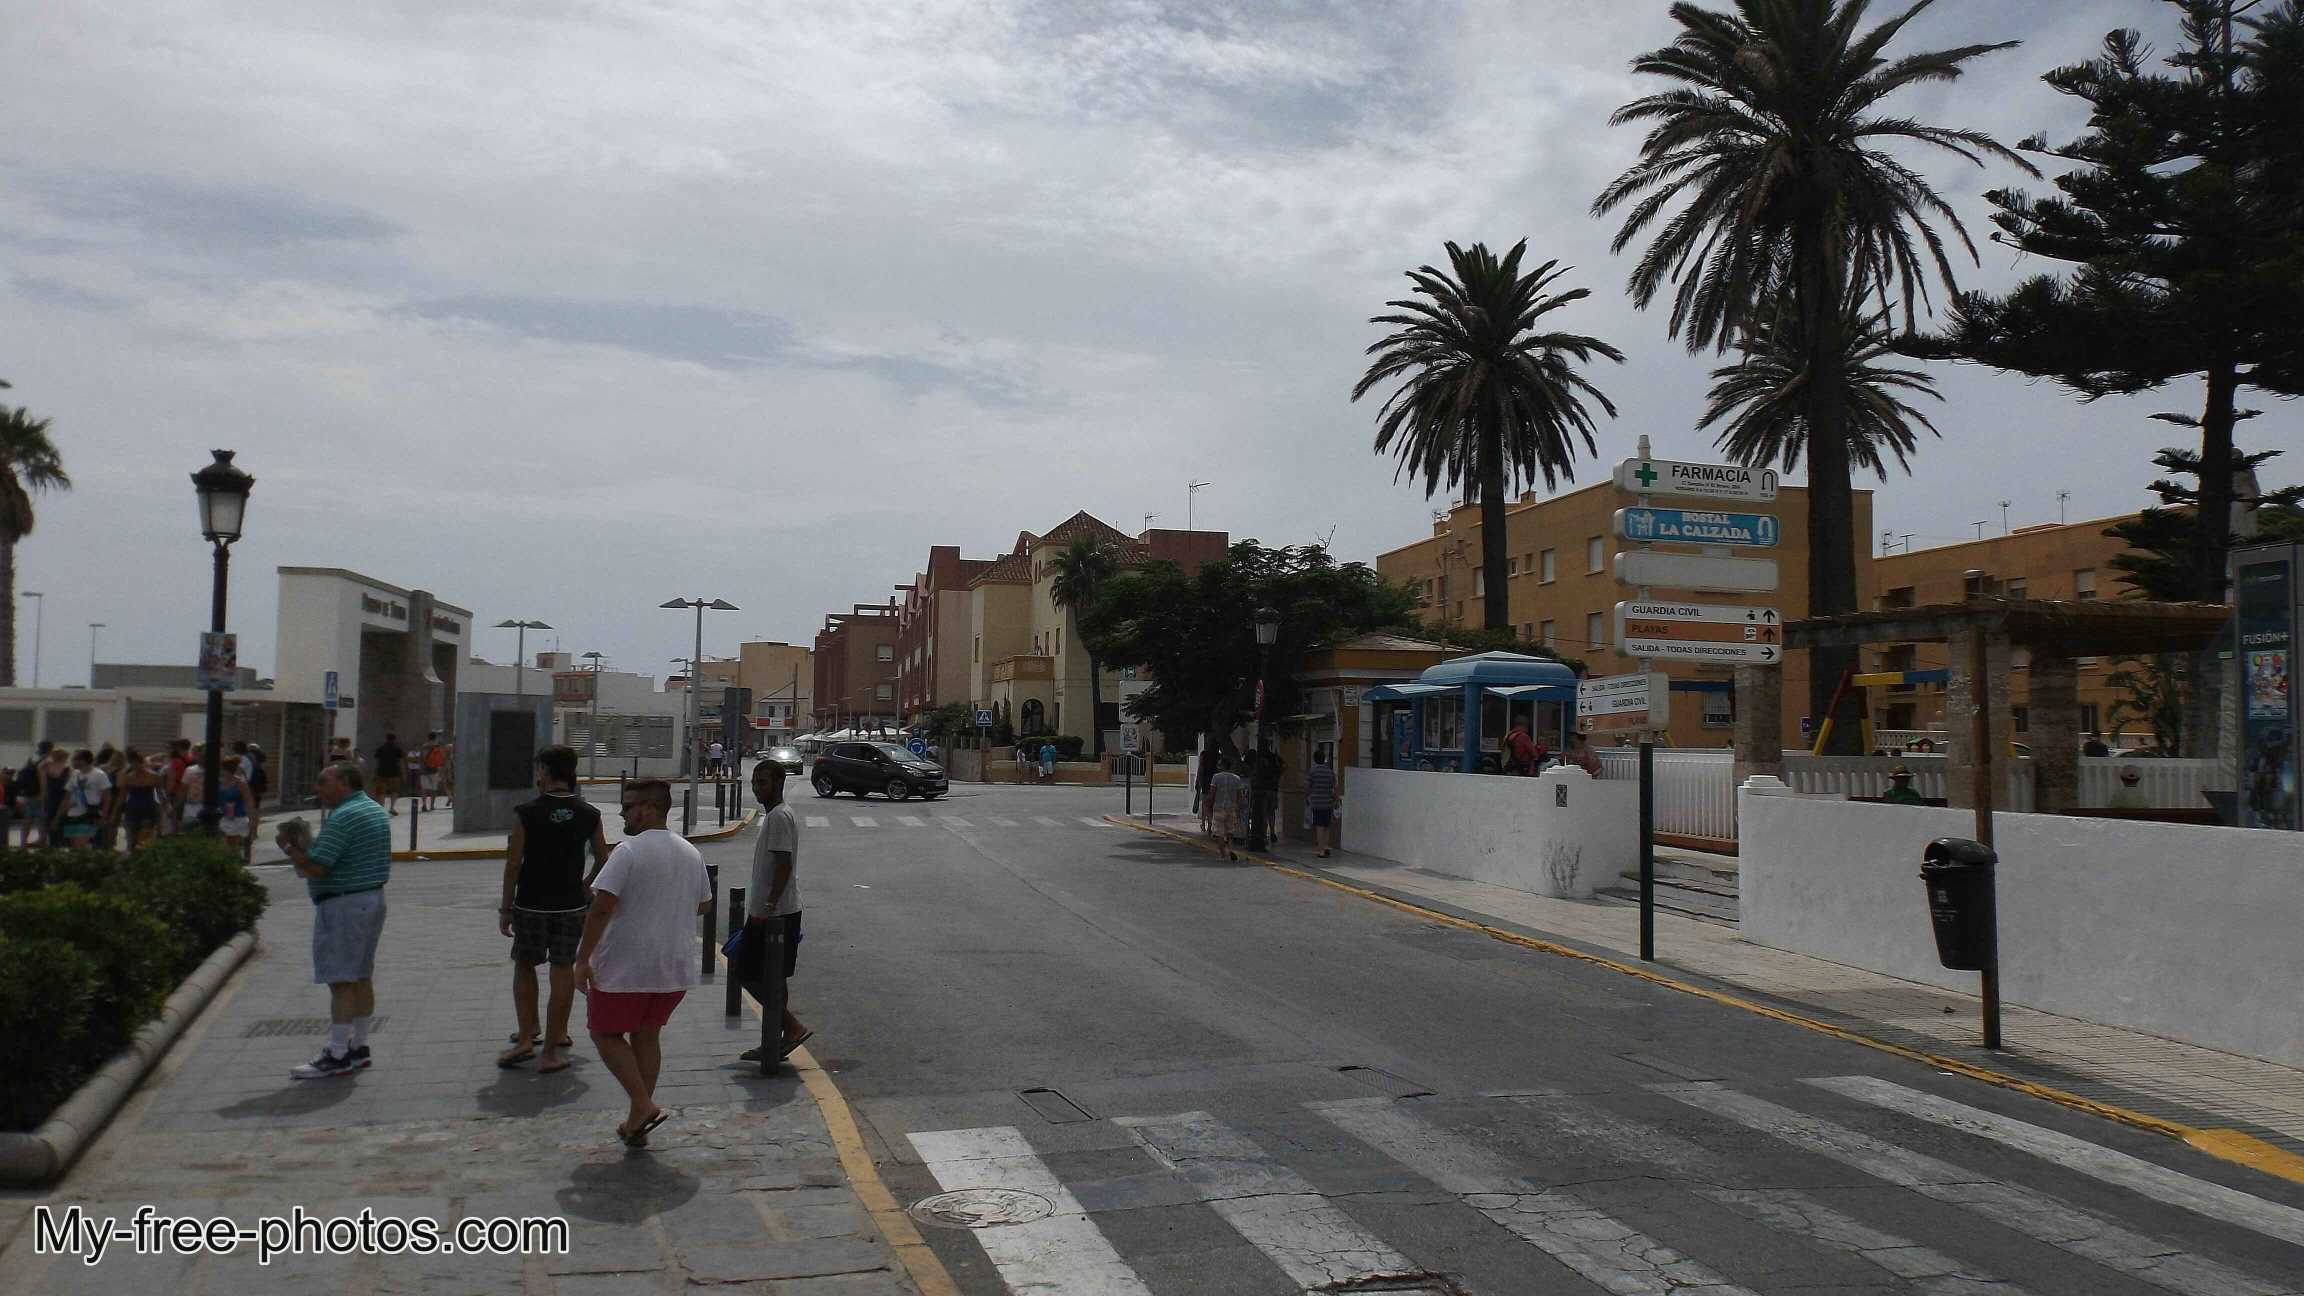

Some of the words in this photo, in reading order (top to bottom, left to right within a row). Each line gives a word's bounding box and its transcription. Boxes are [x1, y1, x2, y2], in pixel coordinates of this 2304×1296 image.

[1672, 466, 1751, 483] FARMACIA
[1682, 512, 1730, 524] HOSTAL
[1659, 523, 1680, 536] LA
[1681, 525, 1751, 539] CALZADA
[1632, 605, 1676, 616] GUARDIA
[1678, 607, 1702, 617] CIVIL
[1631, 625, 1668, 635] PLAYAS
[1631, 644, 1660, 653] SALIDA
[1666, 645, 1693, 655] TODAS
[1694, 647, 1747, 657] DIRECCIONES
